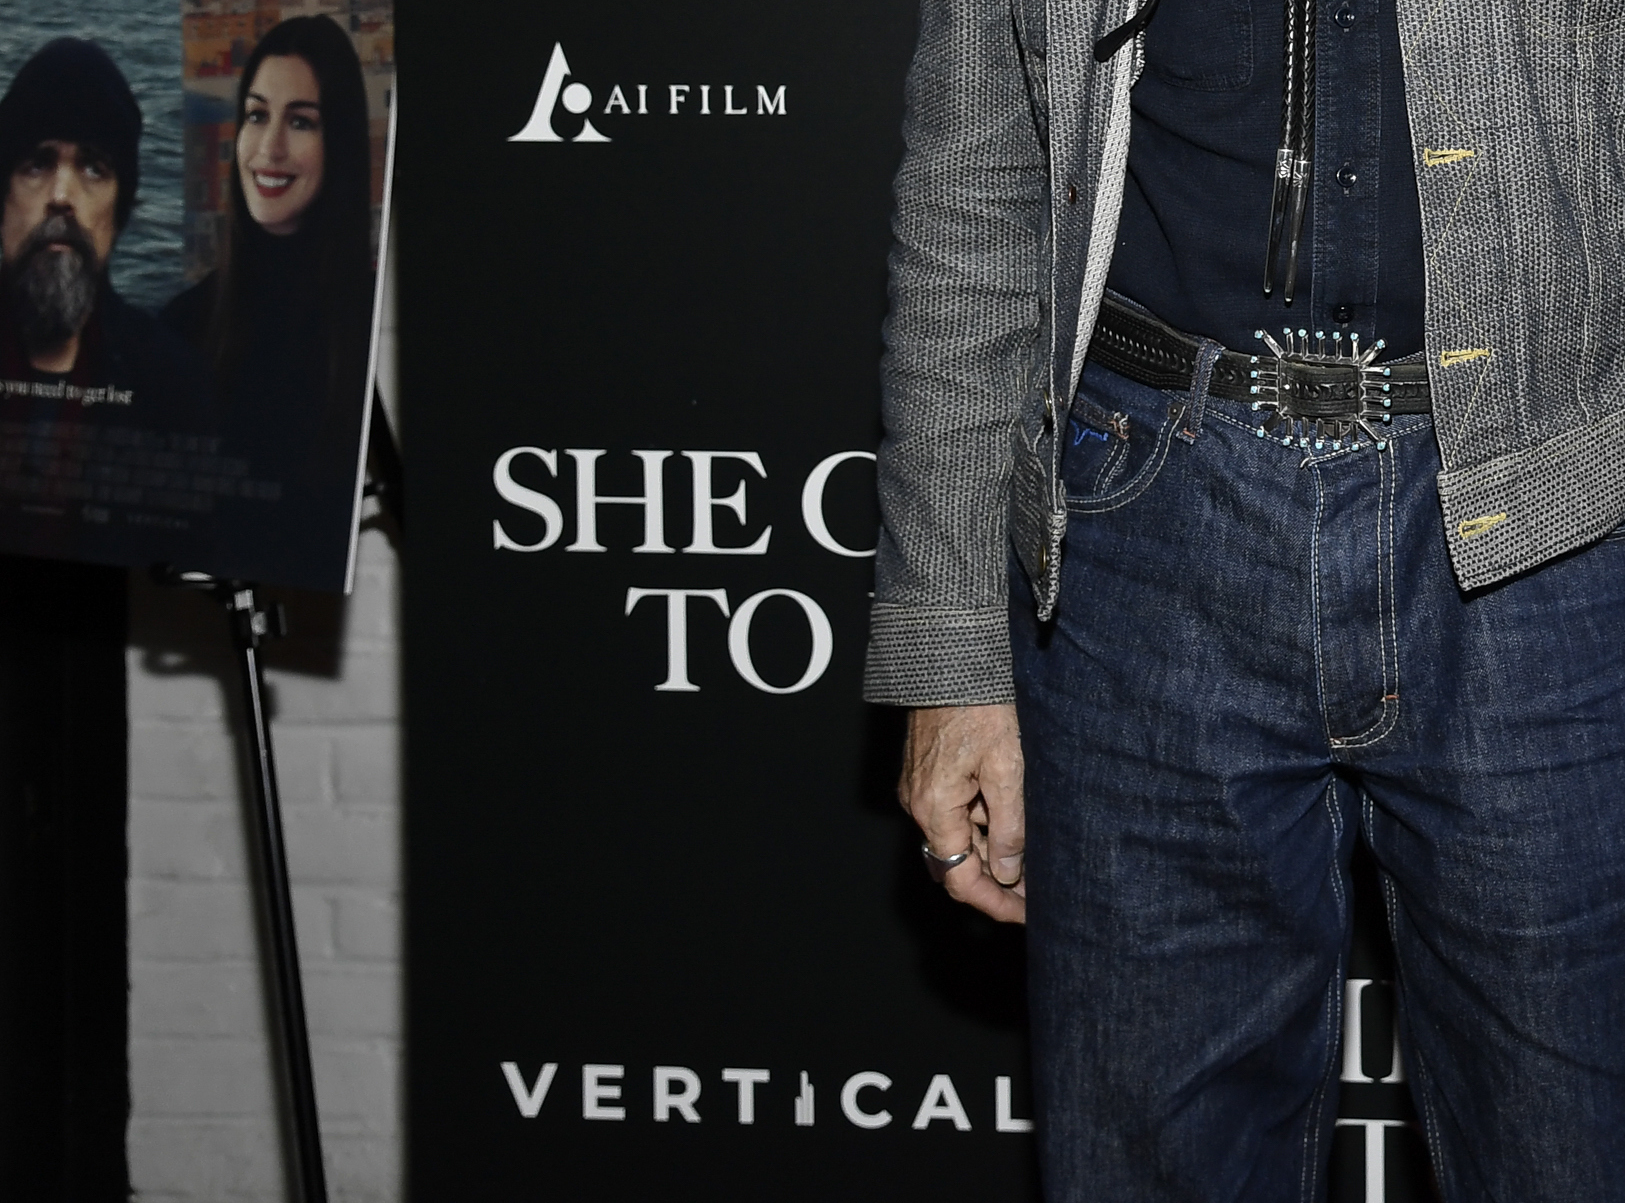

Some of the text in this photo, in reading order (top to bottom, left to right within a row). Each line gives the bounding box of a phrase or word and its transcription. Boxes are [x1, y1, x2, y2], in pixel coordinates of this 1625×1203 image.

[669, 84, 787, 116] FILM
[107, 384, 133, 405] lost
[493, 446, 772, 555] SHE
[625, 587, 833, 694] TO
[501, 1061, 1035, 1133] VERTICAL
